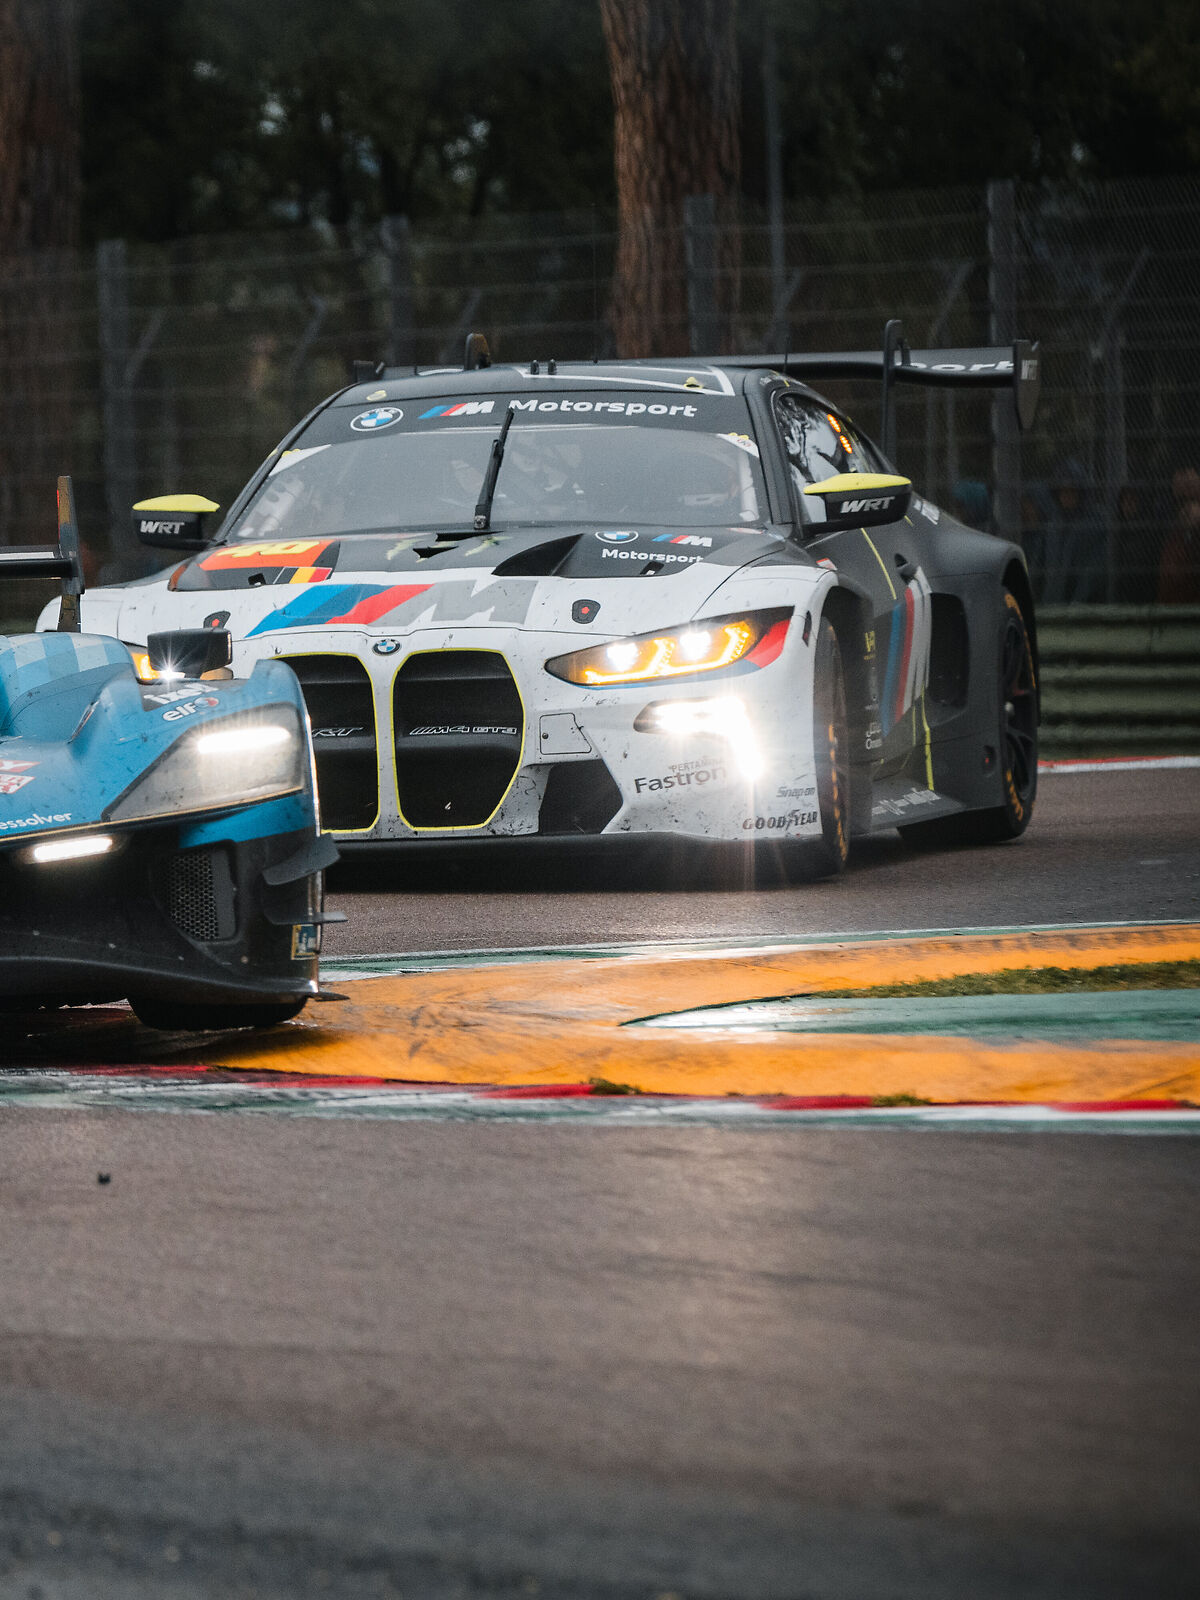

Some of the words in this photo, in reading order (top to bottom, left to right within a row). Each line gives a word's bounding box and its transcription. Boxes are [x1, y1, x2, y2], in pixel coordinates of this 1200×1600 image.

[509, 400, 698, 417] Motorsport
[840, 497, 895, 514] WRT
[140, 521, 185, 534] WRT
[601, 548, 704, 563] Motorsport
[162, 702, 196, 722] elf
[311, 726, 364, 738] RT
[472, 726, 518, 735] GT3
[634, 766, 727, 794] Fastron
[742, 809, 819, 831] GOODYEAR
